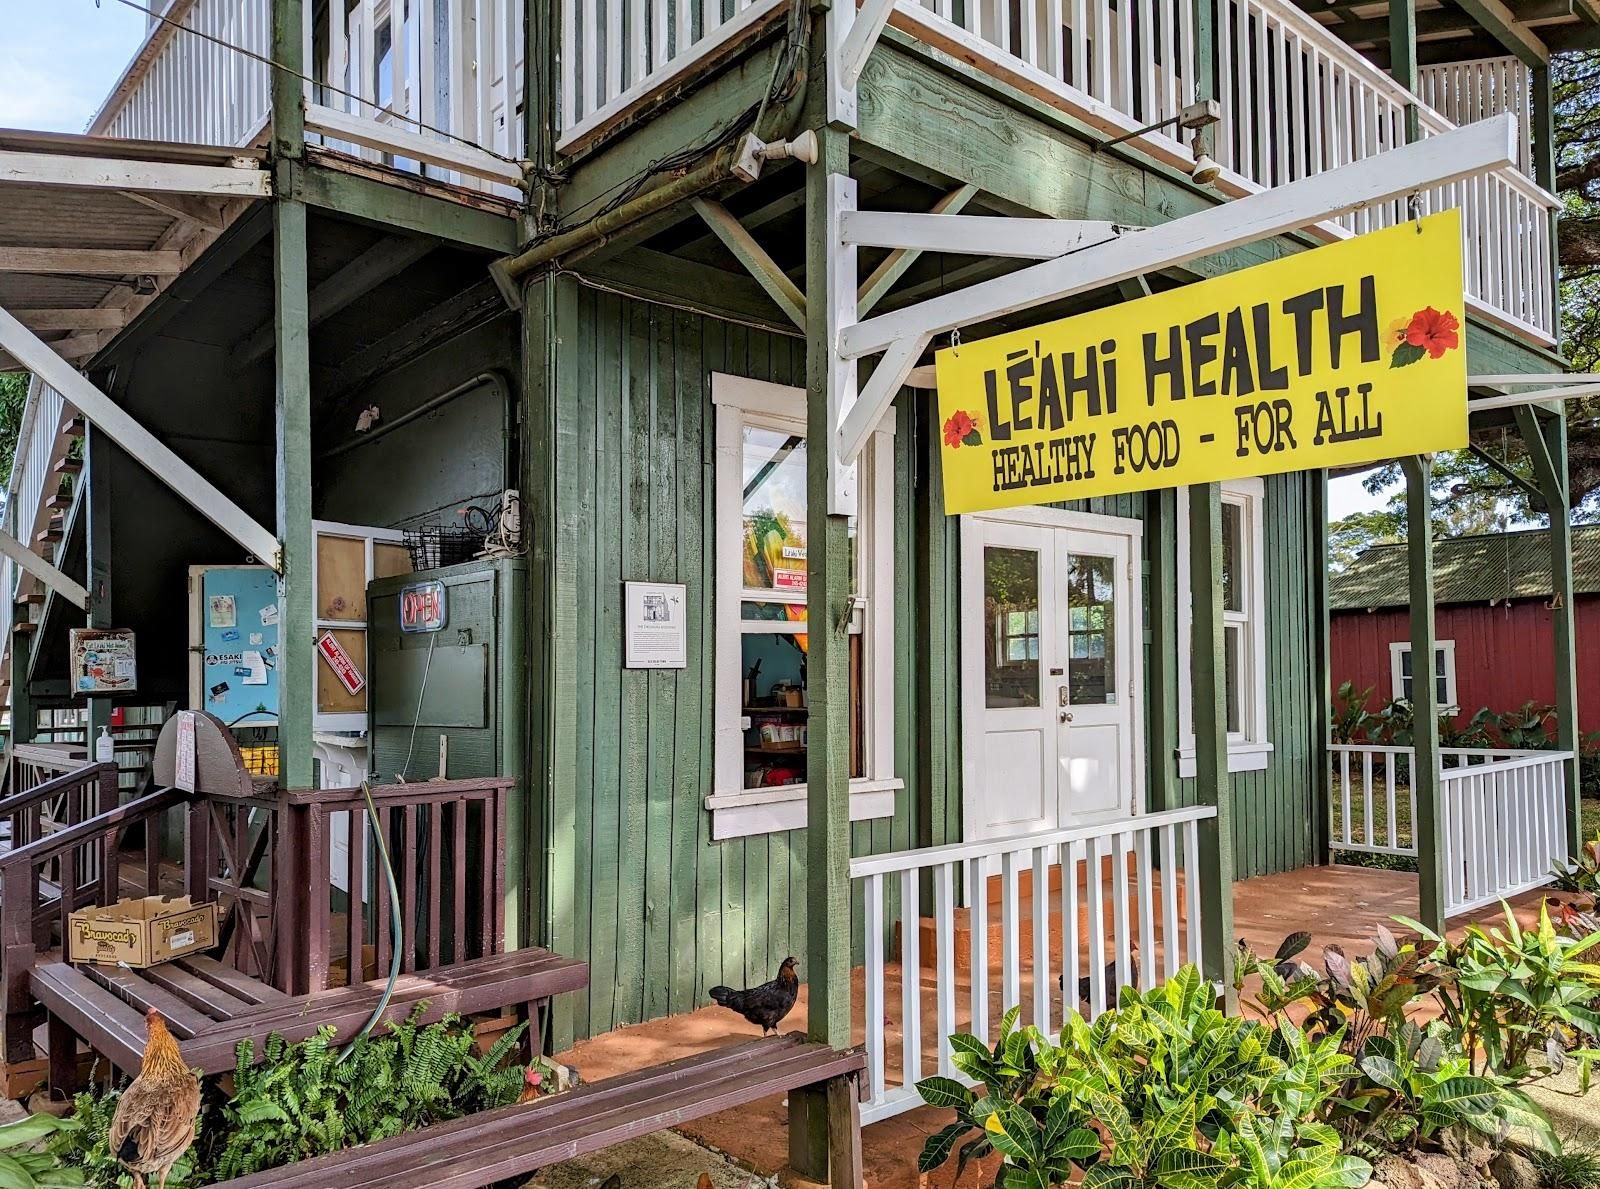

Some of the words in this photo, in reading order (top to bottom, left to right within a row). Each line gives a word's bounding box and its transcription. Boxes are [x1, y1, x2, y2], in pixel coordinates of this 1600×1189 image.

[1142, 275, 1381, 407] HEALTH
[992, 433, 1096, 492] HEALTHY
[1114, 419, 1180, 475] FOOD
[1235, 398, 1297, 457] FOR
[1313, 383, 1382, 446] ALL
[403, 591, 440, 624] OPEN
[158, 914, 204, 931] Bravocado
